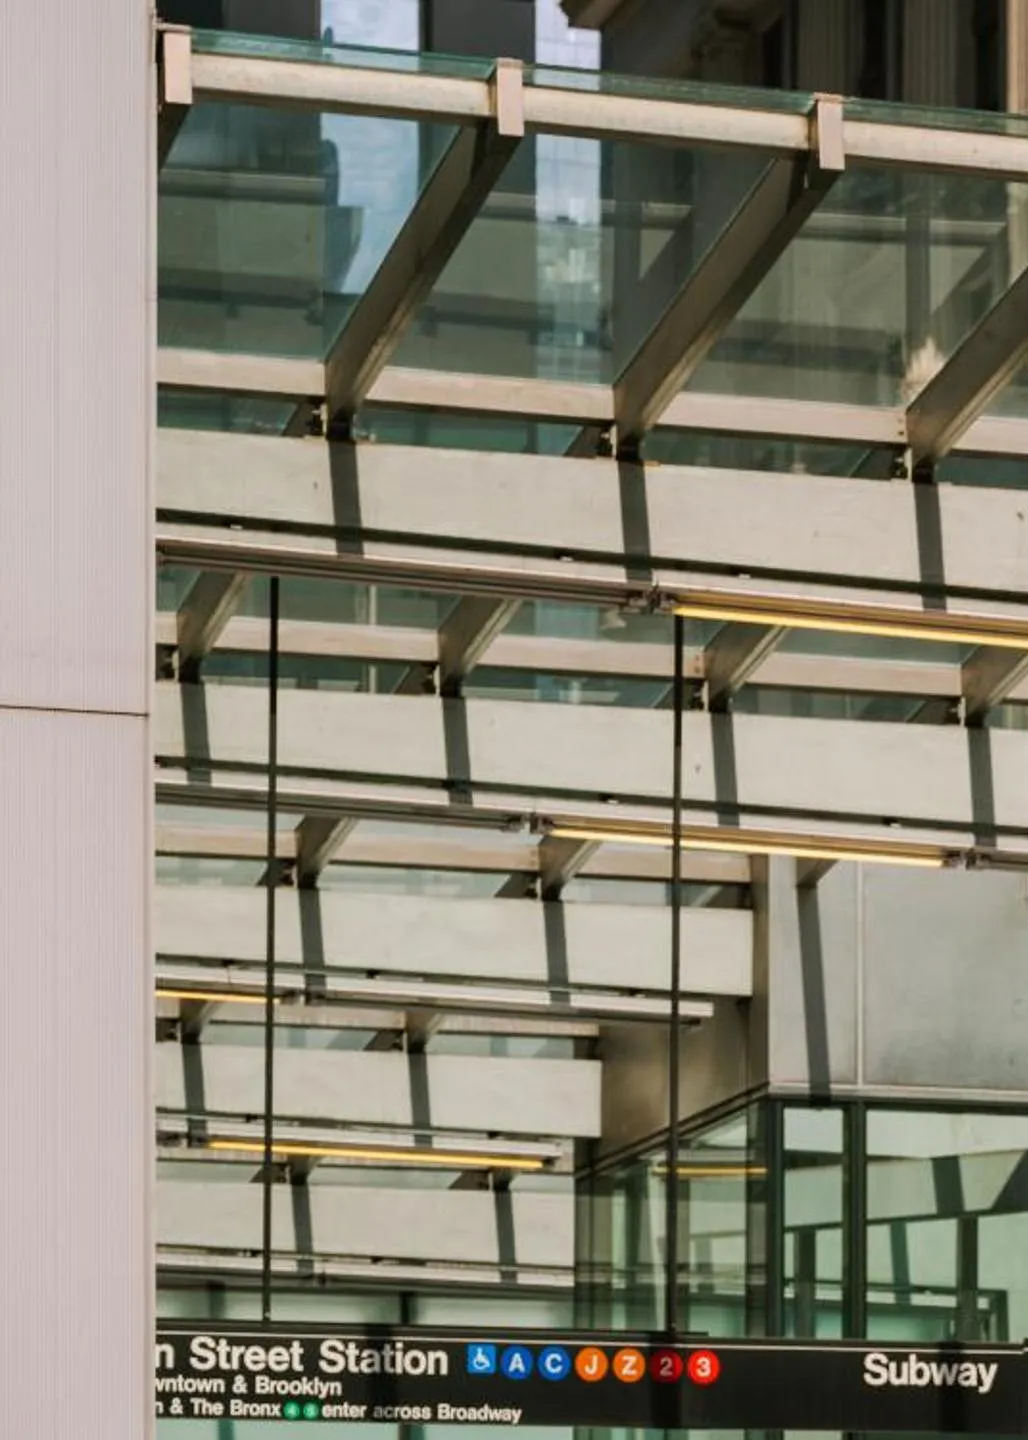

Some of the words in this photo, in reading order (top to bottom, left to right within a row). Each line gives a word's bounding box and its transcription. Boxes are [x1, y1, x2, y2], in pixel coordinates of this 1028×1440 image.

[189, 1336, 304, 1372] Street
[318, 1339, 449, 1375] Station
[232, 1375, 247, 1394] &
[255, 1375, 342, 1399] Brooklyn
[863, 1352, 998, 1394] Subway
[170, 1397, 183, 1415] &
[190, 1397, 224, 1416] The
[230, 1399, 281, 1417] Bronx
[322, 1403, 367, 1418] enter
[374, 1404, 431, 1419] across
[437, 1403, 522, 1424] Broadway
